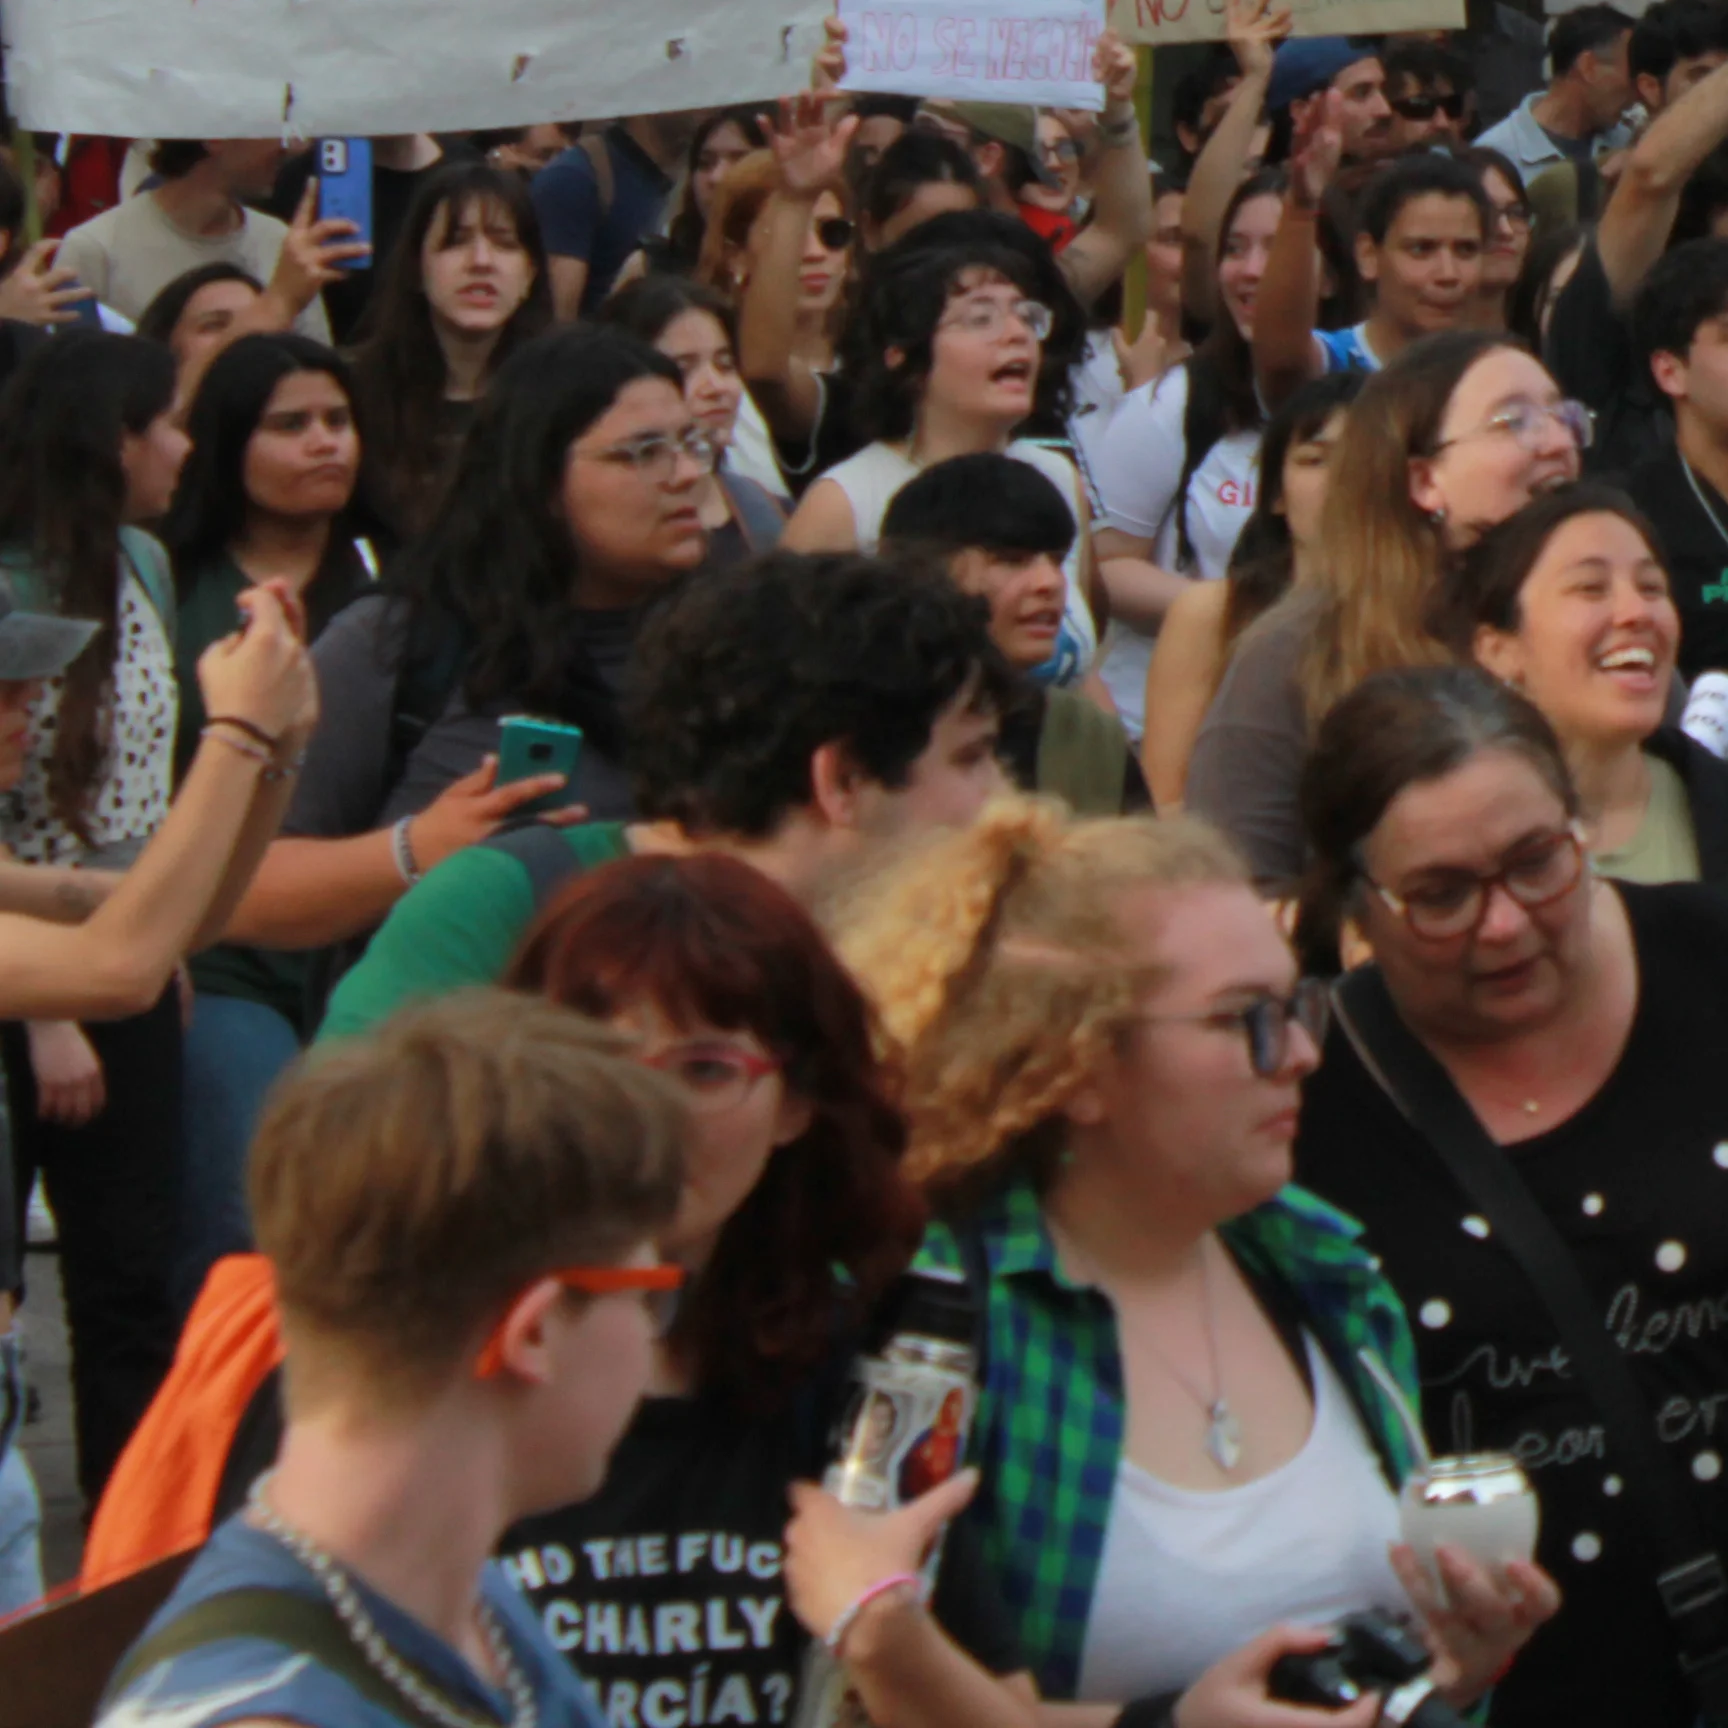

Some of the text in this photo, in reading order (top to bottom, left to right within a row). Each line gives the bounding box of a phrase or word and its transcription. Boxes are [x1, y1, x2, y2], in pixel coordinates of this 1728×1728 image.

[862, 10, 919, 73] NO
[932, 16, 977, 78] SE
[582, 1534, 670, 1581] THE
[542, 1597, 782, 1656] CHARLY
